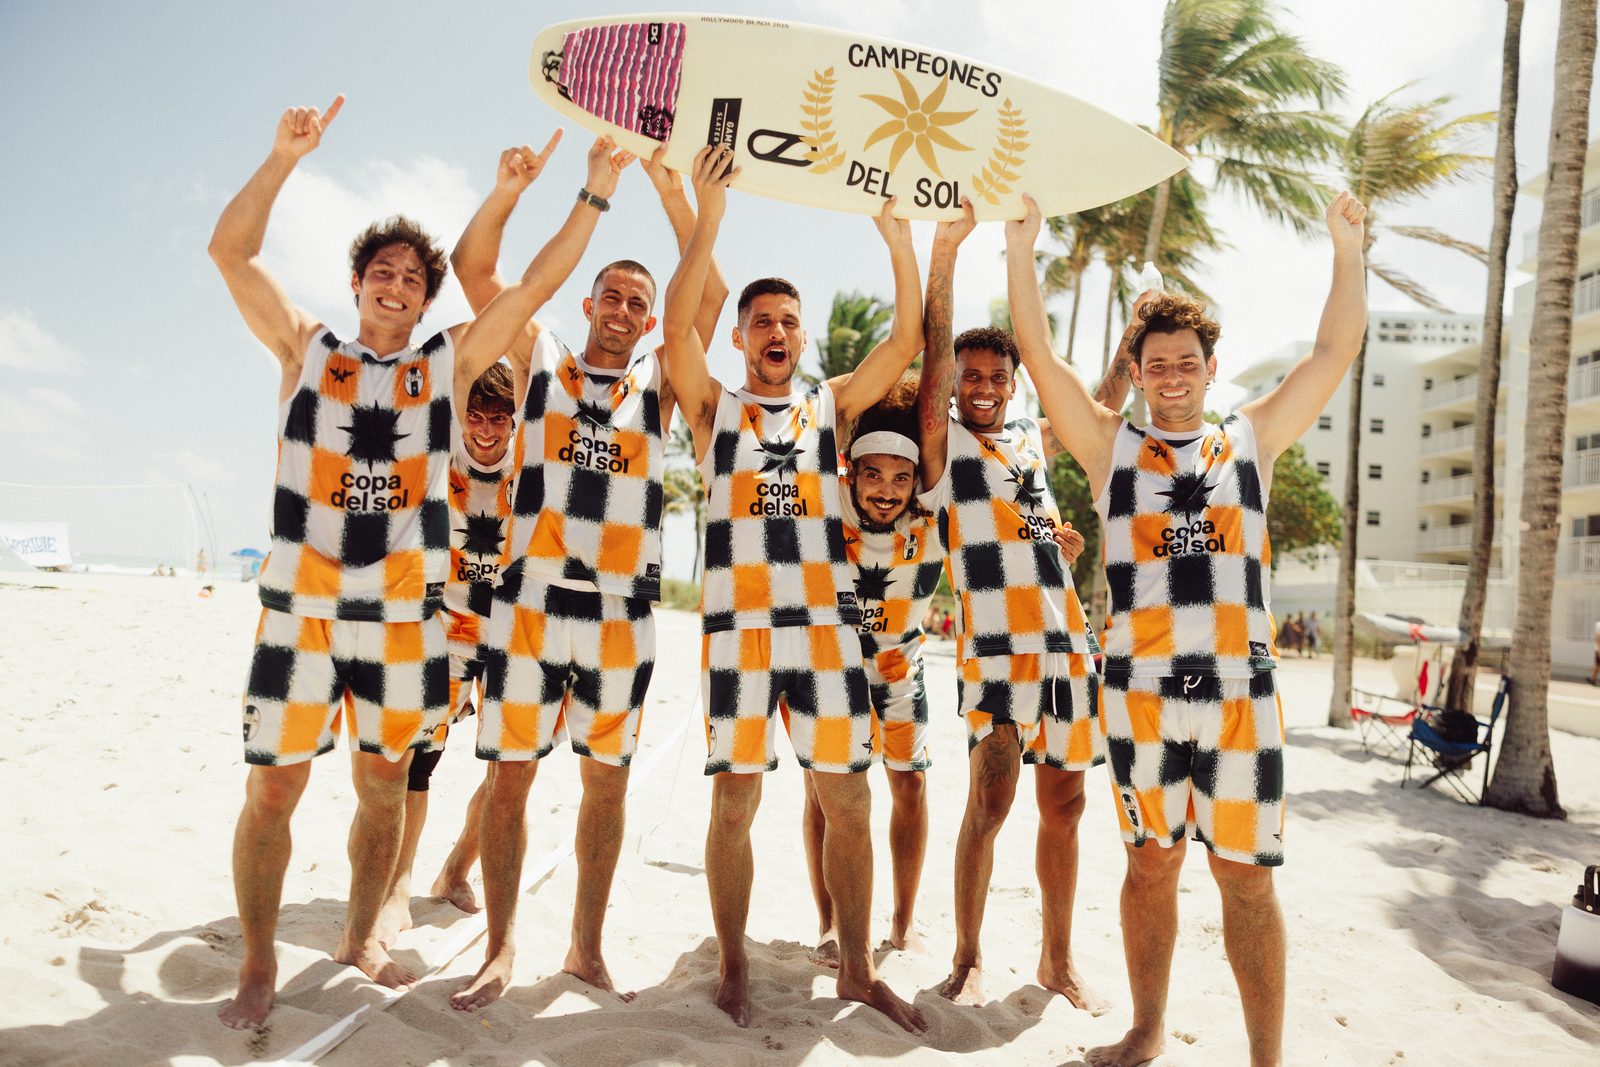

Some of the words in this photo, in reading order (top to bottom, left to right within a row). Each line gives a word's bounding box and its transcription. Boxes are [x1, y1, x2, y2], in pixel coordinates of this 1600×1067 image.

[700, 16, 744, 24] HOLLYWOOD
[746, 19, 771, 27] BEACH
[848, 43, 1001, 98] CAMPEONES
[713, 111, 724, 143] SLATER
[846, 160, 893, 199] DEL
[914, 178, 963, 209] SOL
[568, 429, 622, 457] copa
[558, 443, 592, 468] del
[595, 455, 629, 474] sol
[340, 472, 402, 494] copa
[756, 482, 799, 501] copa
[331, 489, 368, 511] del
[373, 490, 408, 511] sol
[749, 498, 780, 516] del
[782, 499, 808, 517] sol
[1160, 520, 1216, 542] copa
[1153, 537, 1189, 558] del
[1191, 534, 1226, 553] sol
[859, 606, 885, 621] pa
[861, 618, 889, 633] sol
